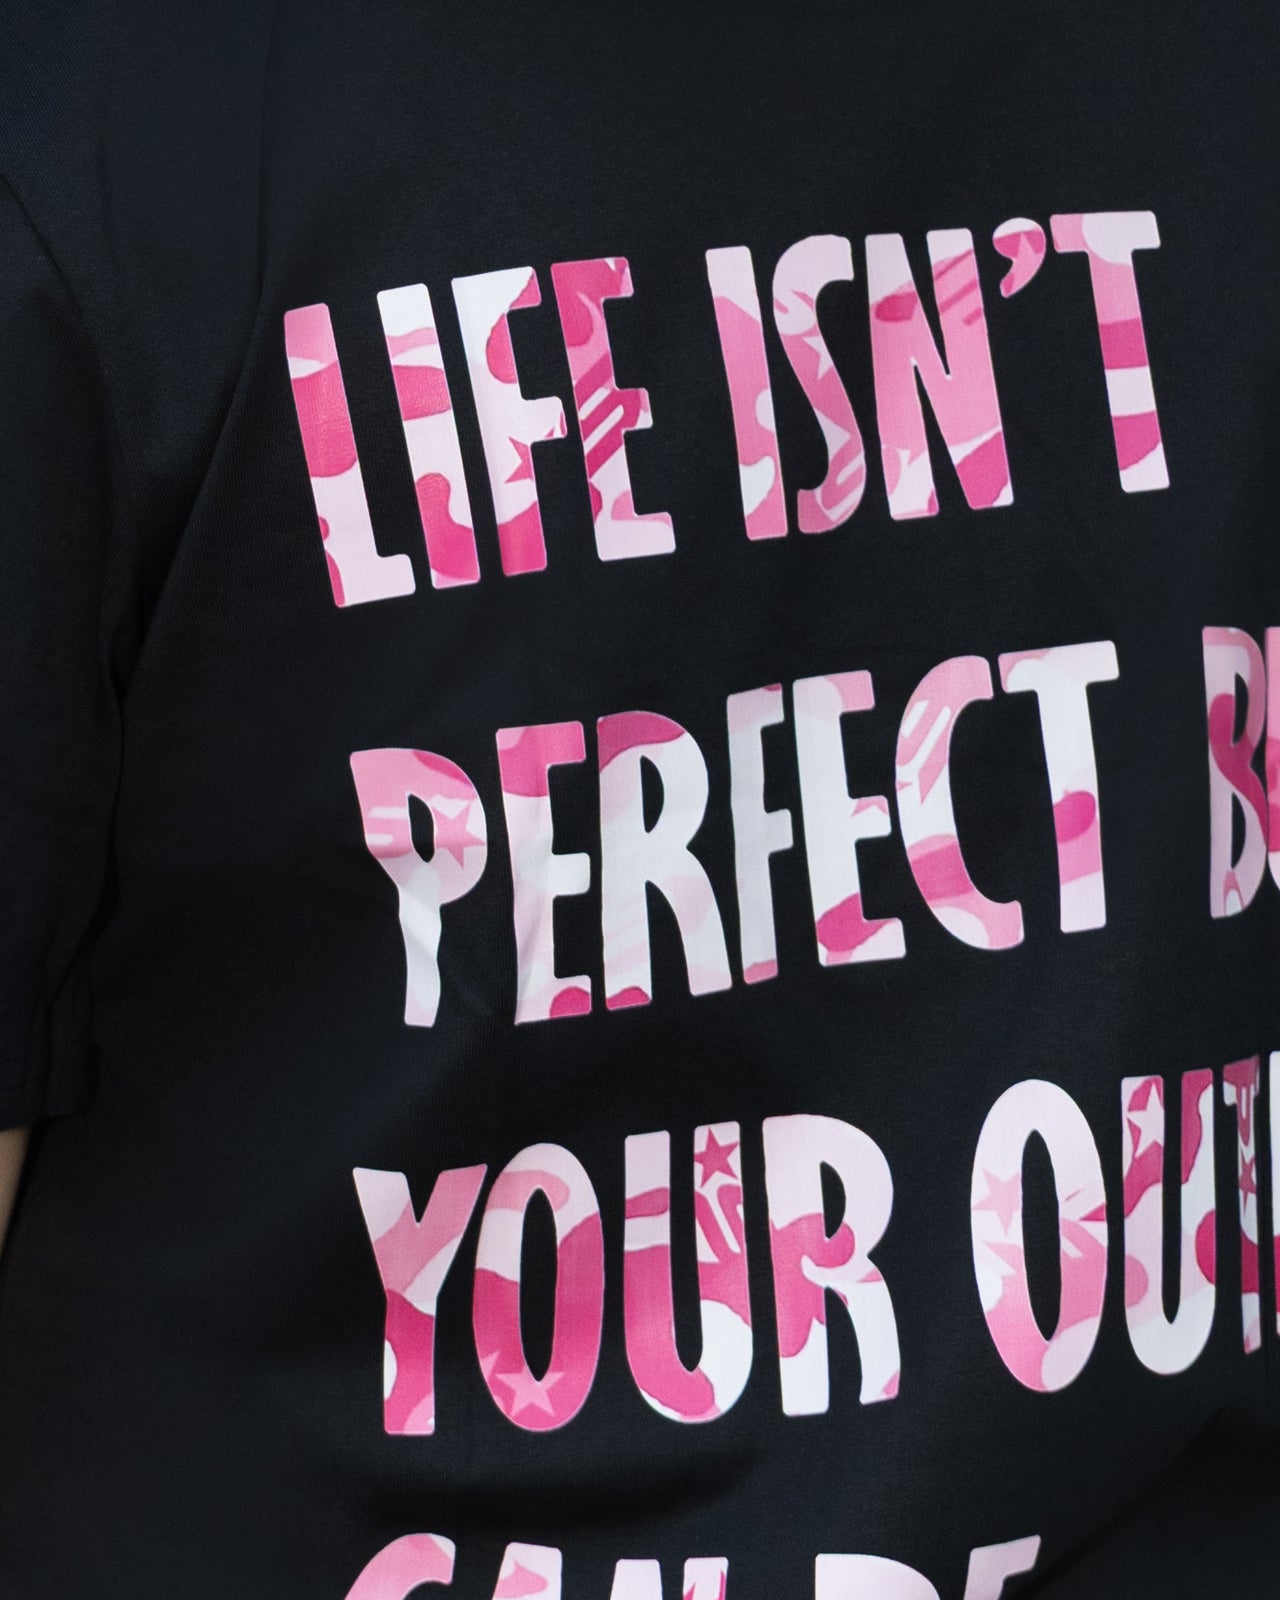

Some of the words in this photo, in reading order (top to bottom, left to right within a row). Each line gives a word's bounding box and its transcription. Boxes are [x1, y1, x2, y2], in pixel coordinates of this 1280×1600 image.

[283, 256, 677, 608] LIFE
[705, 210, 1171, 540] ISN'T
[349, 640, 1119, 1027] PERFECT
[352, 1113, 902, 1436] YOUR
